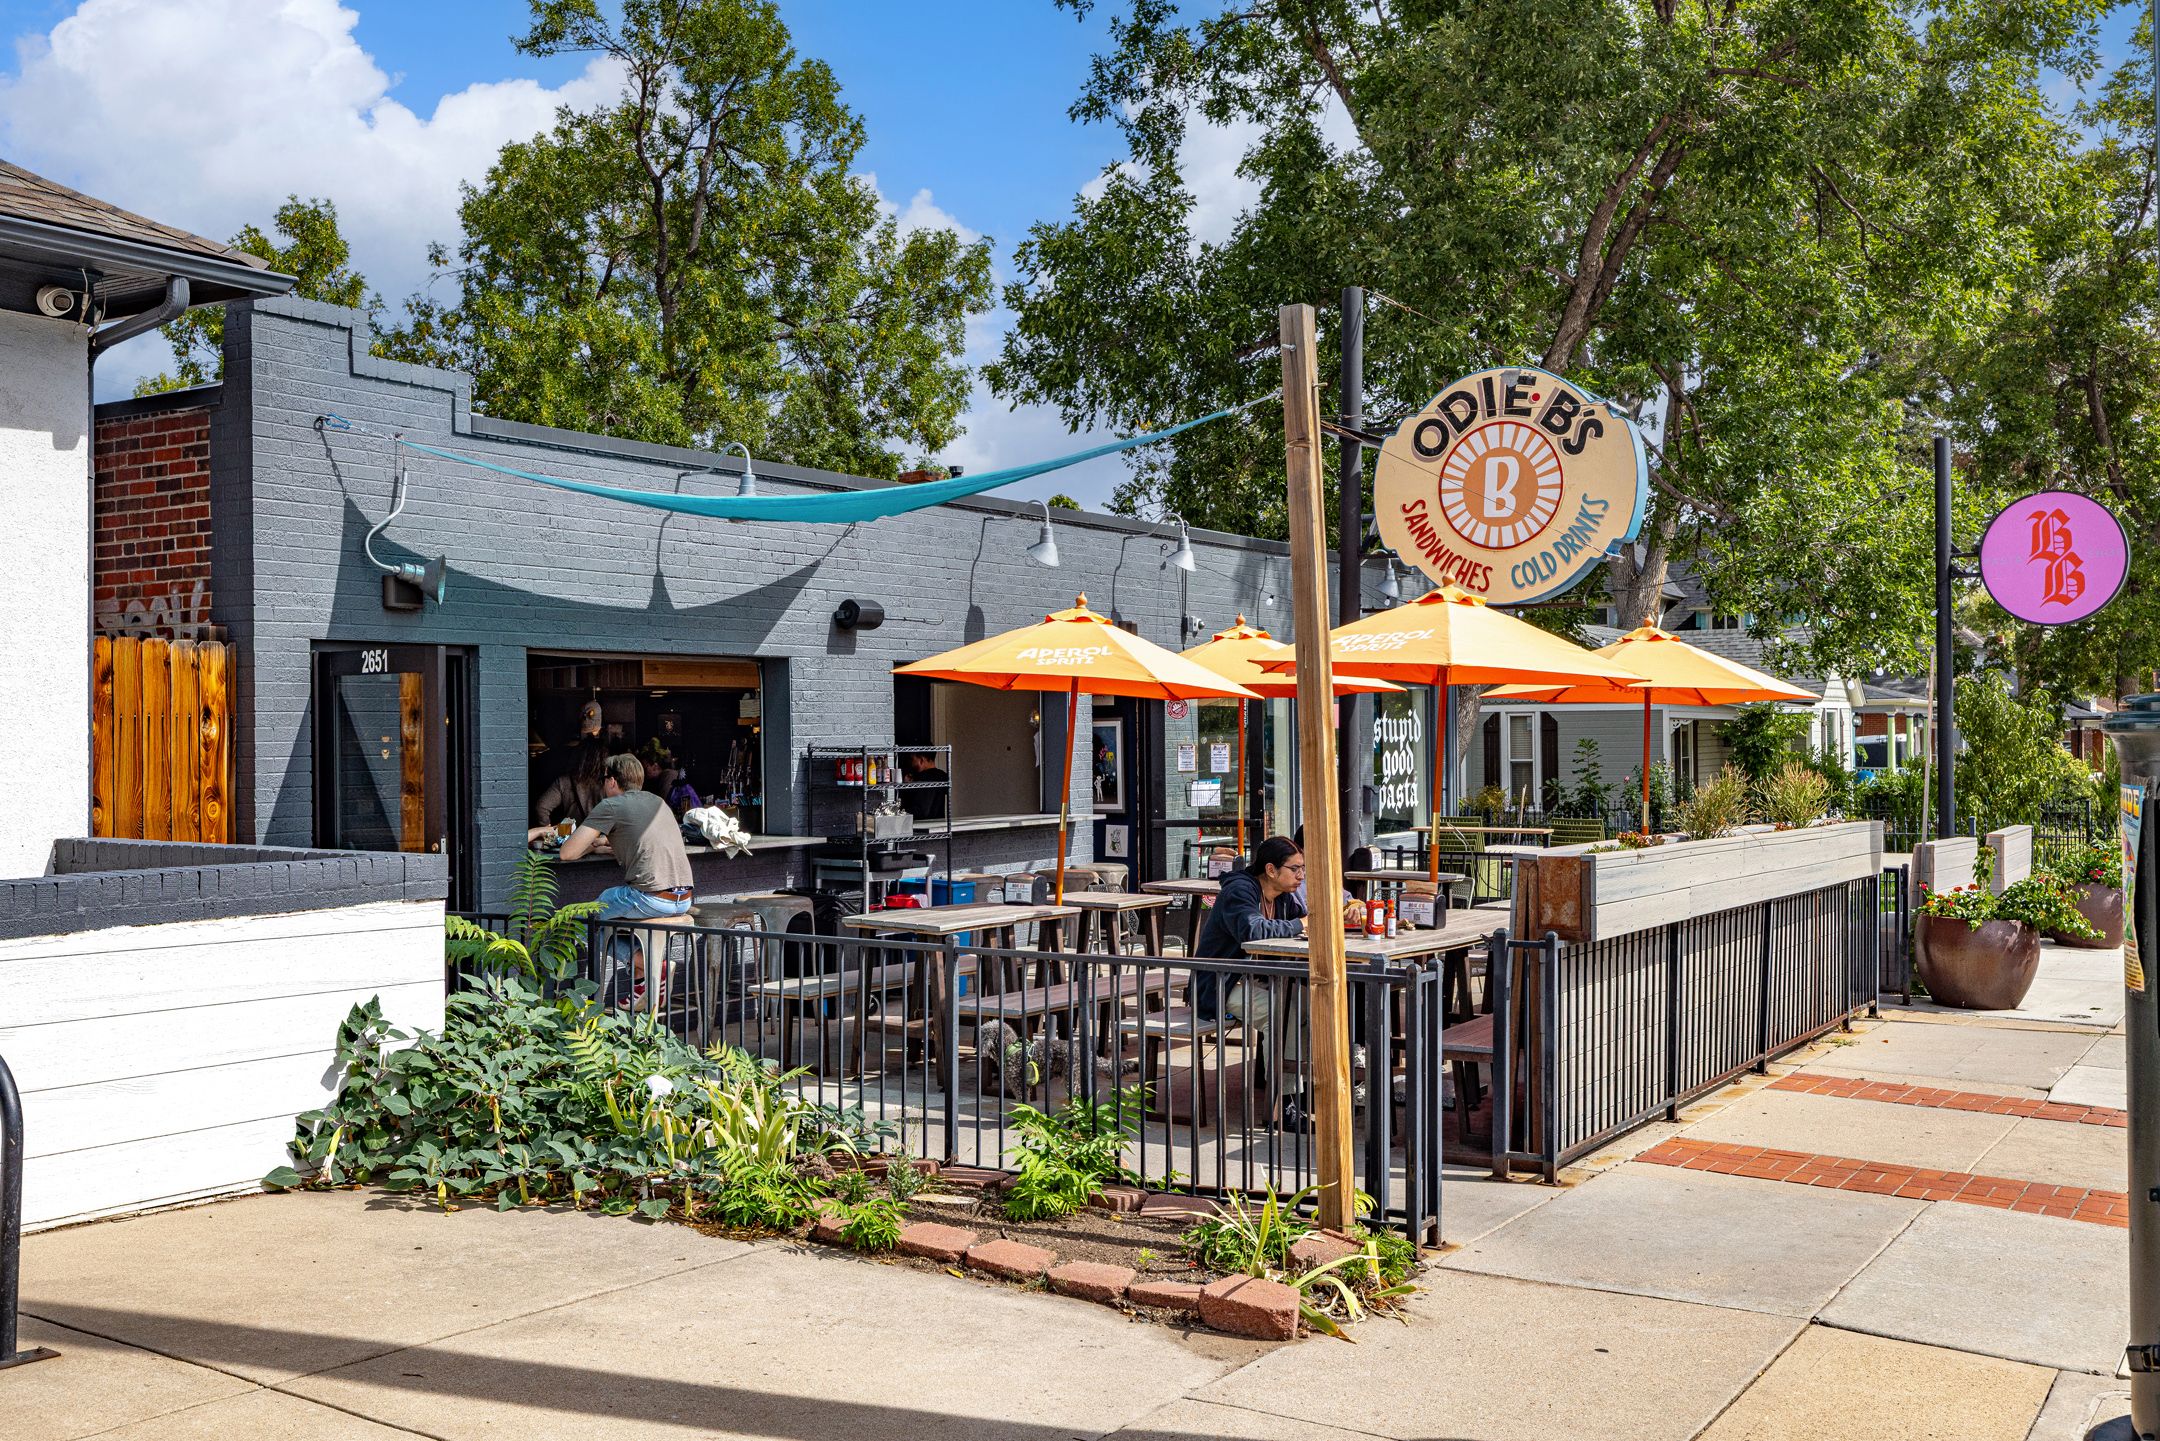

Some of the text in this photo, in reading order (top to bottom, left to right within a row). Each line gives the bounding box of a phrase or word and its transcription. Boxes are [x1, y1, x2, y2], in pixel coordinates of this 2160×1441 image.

[1412, 375, 1537, 459] ODIE
[1483, 456, 1520, 518] B
[1401, 498, 1494, 593] SANDWICHES
[1510, 492, 1610, 590] COLD DRINKS
[1016, 645, 1112, 659] APEROL
[1331, 629, 1435, 646] APEROL
[1340, 641, 1408, 652] SPRITZ
[361, 649, 388, 674] 2651
[1036, 656, 1094, 666] SPRITZ
[1373, 708, 1421, 751] stupid
[1382, 740, 1414, 784] good
[1379, 775, 1419, 820] pasta
